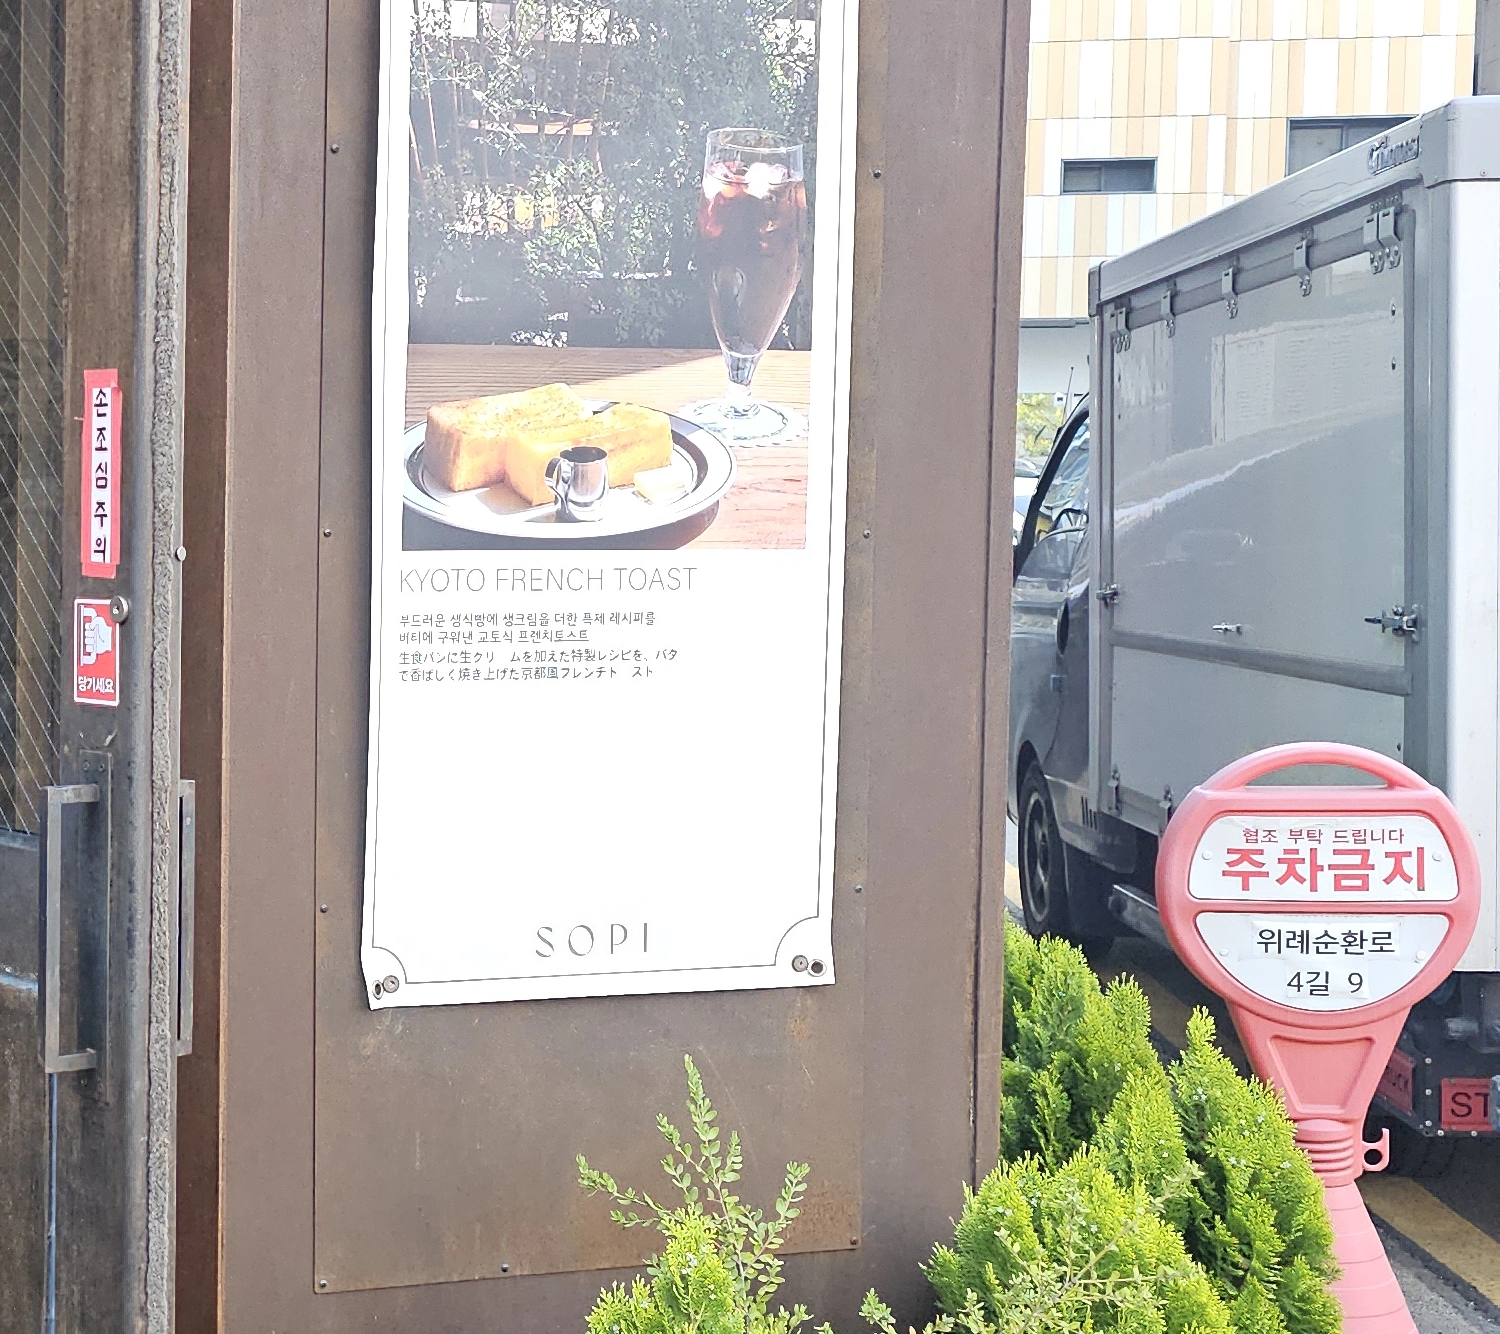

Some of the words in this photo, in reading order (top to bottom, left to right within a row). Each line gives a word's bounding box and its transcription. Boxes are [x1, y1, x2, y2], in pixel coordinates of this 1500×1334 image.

[399, 567, 486, 593] KYOTO
[495, 566, 604, 592] FRENCH
[614, 566, 698, 591] TOAST
[399, 613, 446, 628] 부드러운
[554, 612, 578, 627] 더한
[609, 611, 656, 626] 레시피를
[437, 630, 473, 645] 구워낸
[477, 629, 513, 644] 교토식
[77, 676, 115, 694] 당기세요
[1242, 828, 1278, 845] 협조
[1286, 827, 1324, 845] 부탁
[1332, 827, 1405, 845] 드립니다
[1221, 846, 1425, 893] 주차금지
[535, 923, 648, 959] SOPI
[1256, 929, 1396, 956] 위례순환로
[1286, 970, 1331, 998] 4길
[1347, 972, 1364, 994] 9
